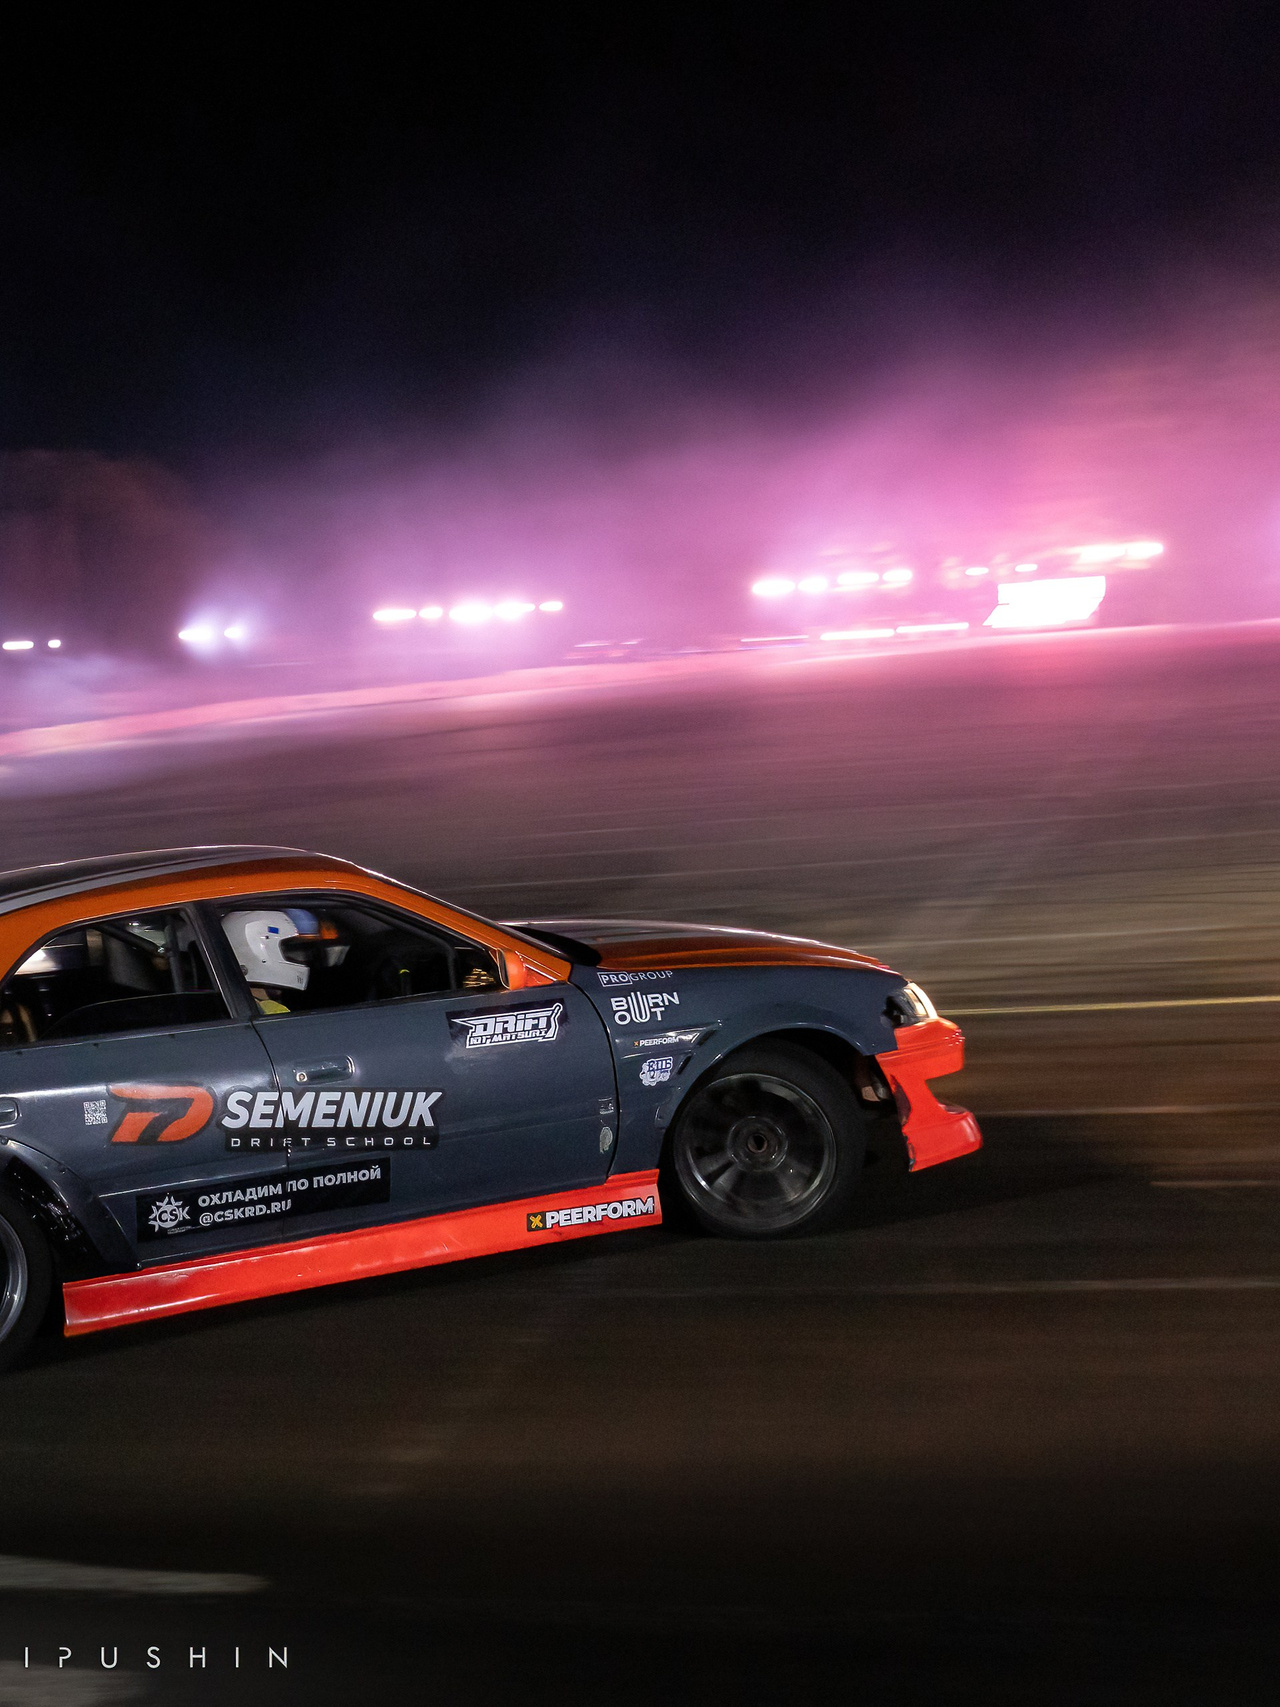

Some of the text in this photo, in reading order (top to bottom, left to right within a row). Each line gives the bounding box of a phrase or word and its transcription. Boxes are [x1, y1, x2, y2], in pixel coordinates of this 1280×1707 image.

[610, 991, 680, 1016] BURN
[639, 1036, 680, 1047] PEERFORM
[221, 1090, 443, 1129] SEMENIUK
[230, 1136, 431, 1148] DRIFT SCHOOL
[197, 1165, 381, 1208] ОХЛАДИМ ПО ПОЛНОЙ
[199, 1199, 292, 1227] @CSKRD.RU
[546, 1197, 654, 1229] PEERFORM
